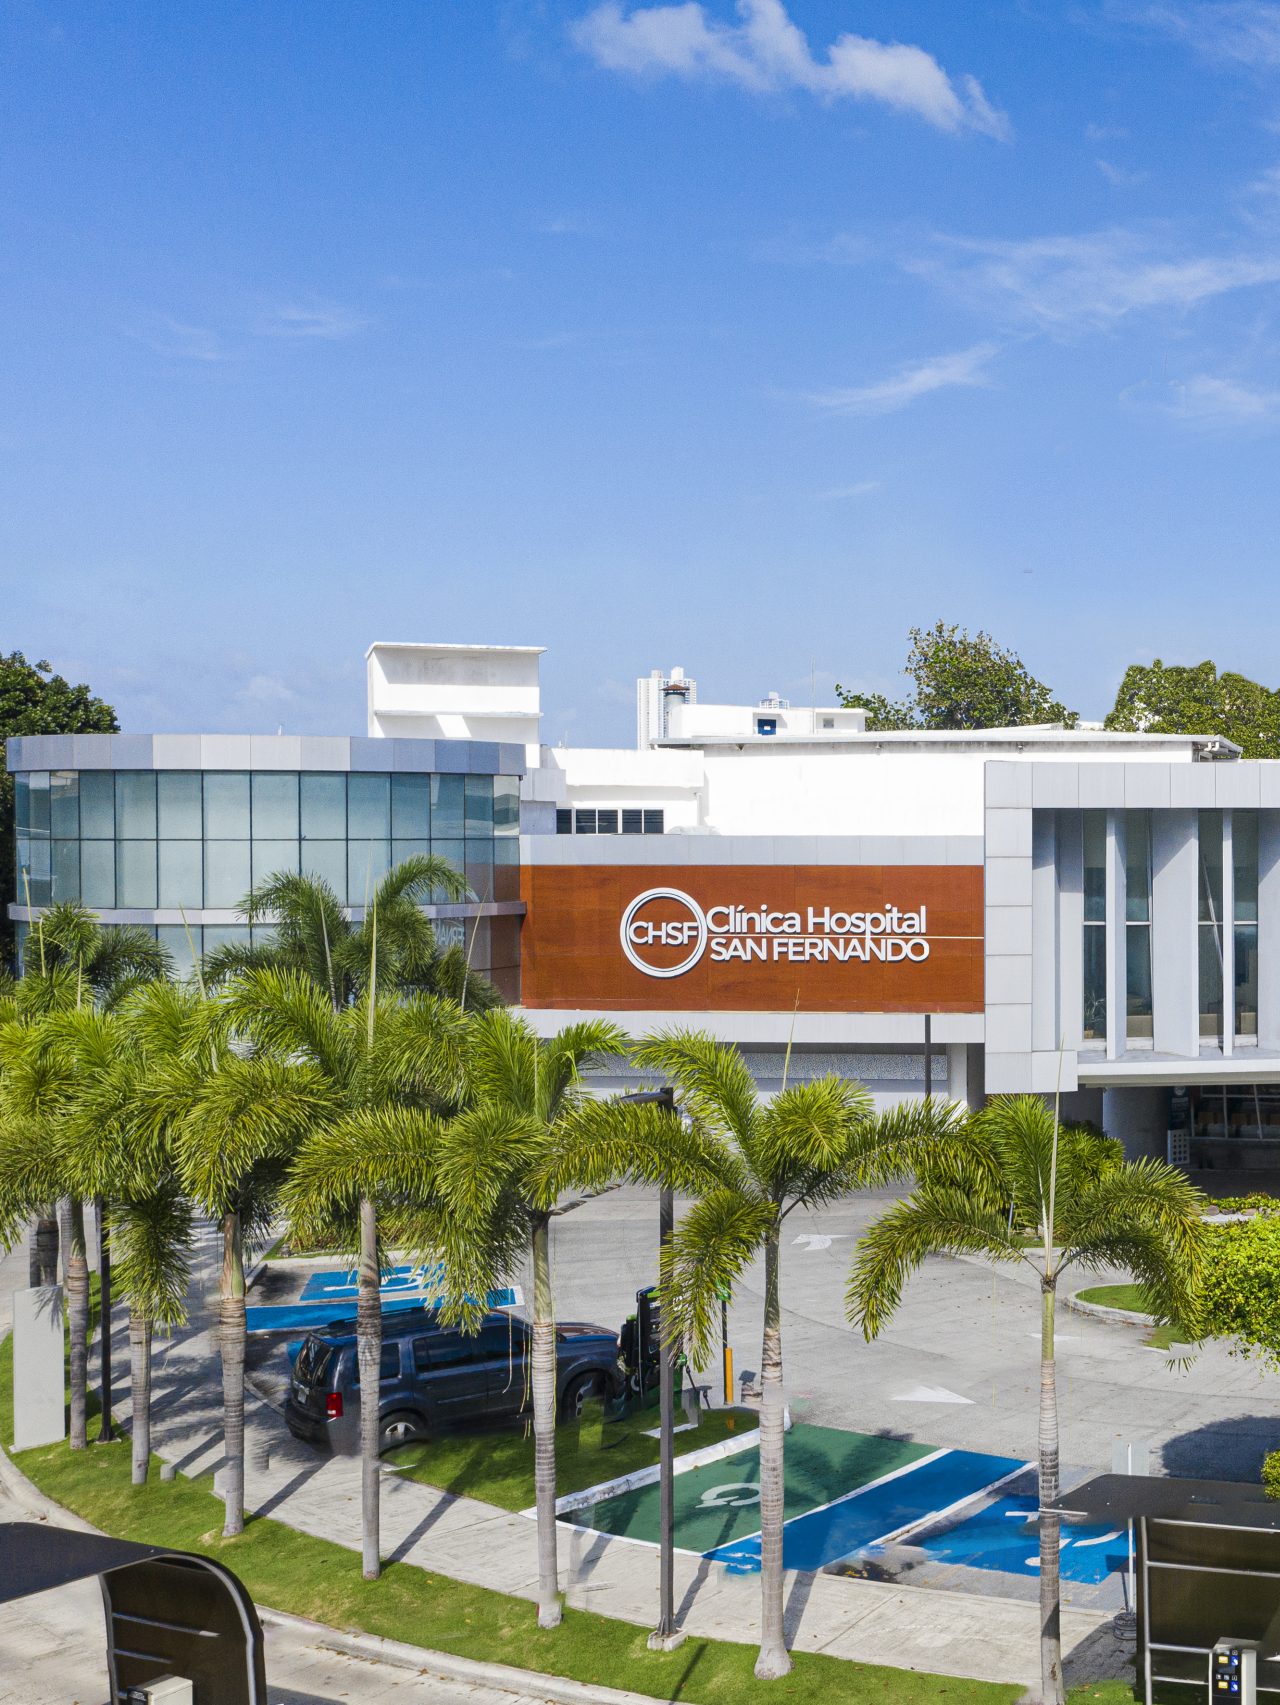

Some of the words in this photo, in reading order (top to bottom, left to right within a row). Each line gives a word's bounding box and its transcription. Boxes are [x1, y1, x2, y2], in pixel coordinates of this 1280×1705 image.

[628, 921, 699, 945] CHSF
[706, 904, 801, 934] Clínica
[808, 903, 927, 940] Hospital
[710, 938, 767, 962] SAN
[773, 938, 930, 962] FERNANDO
